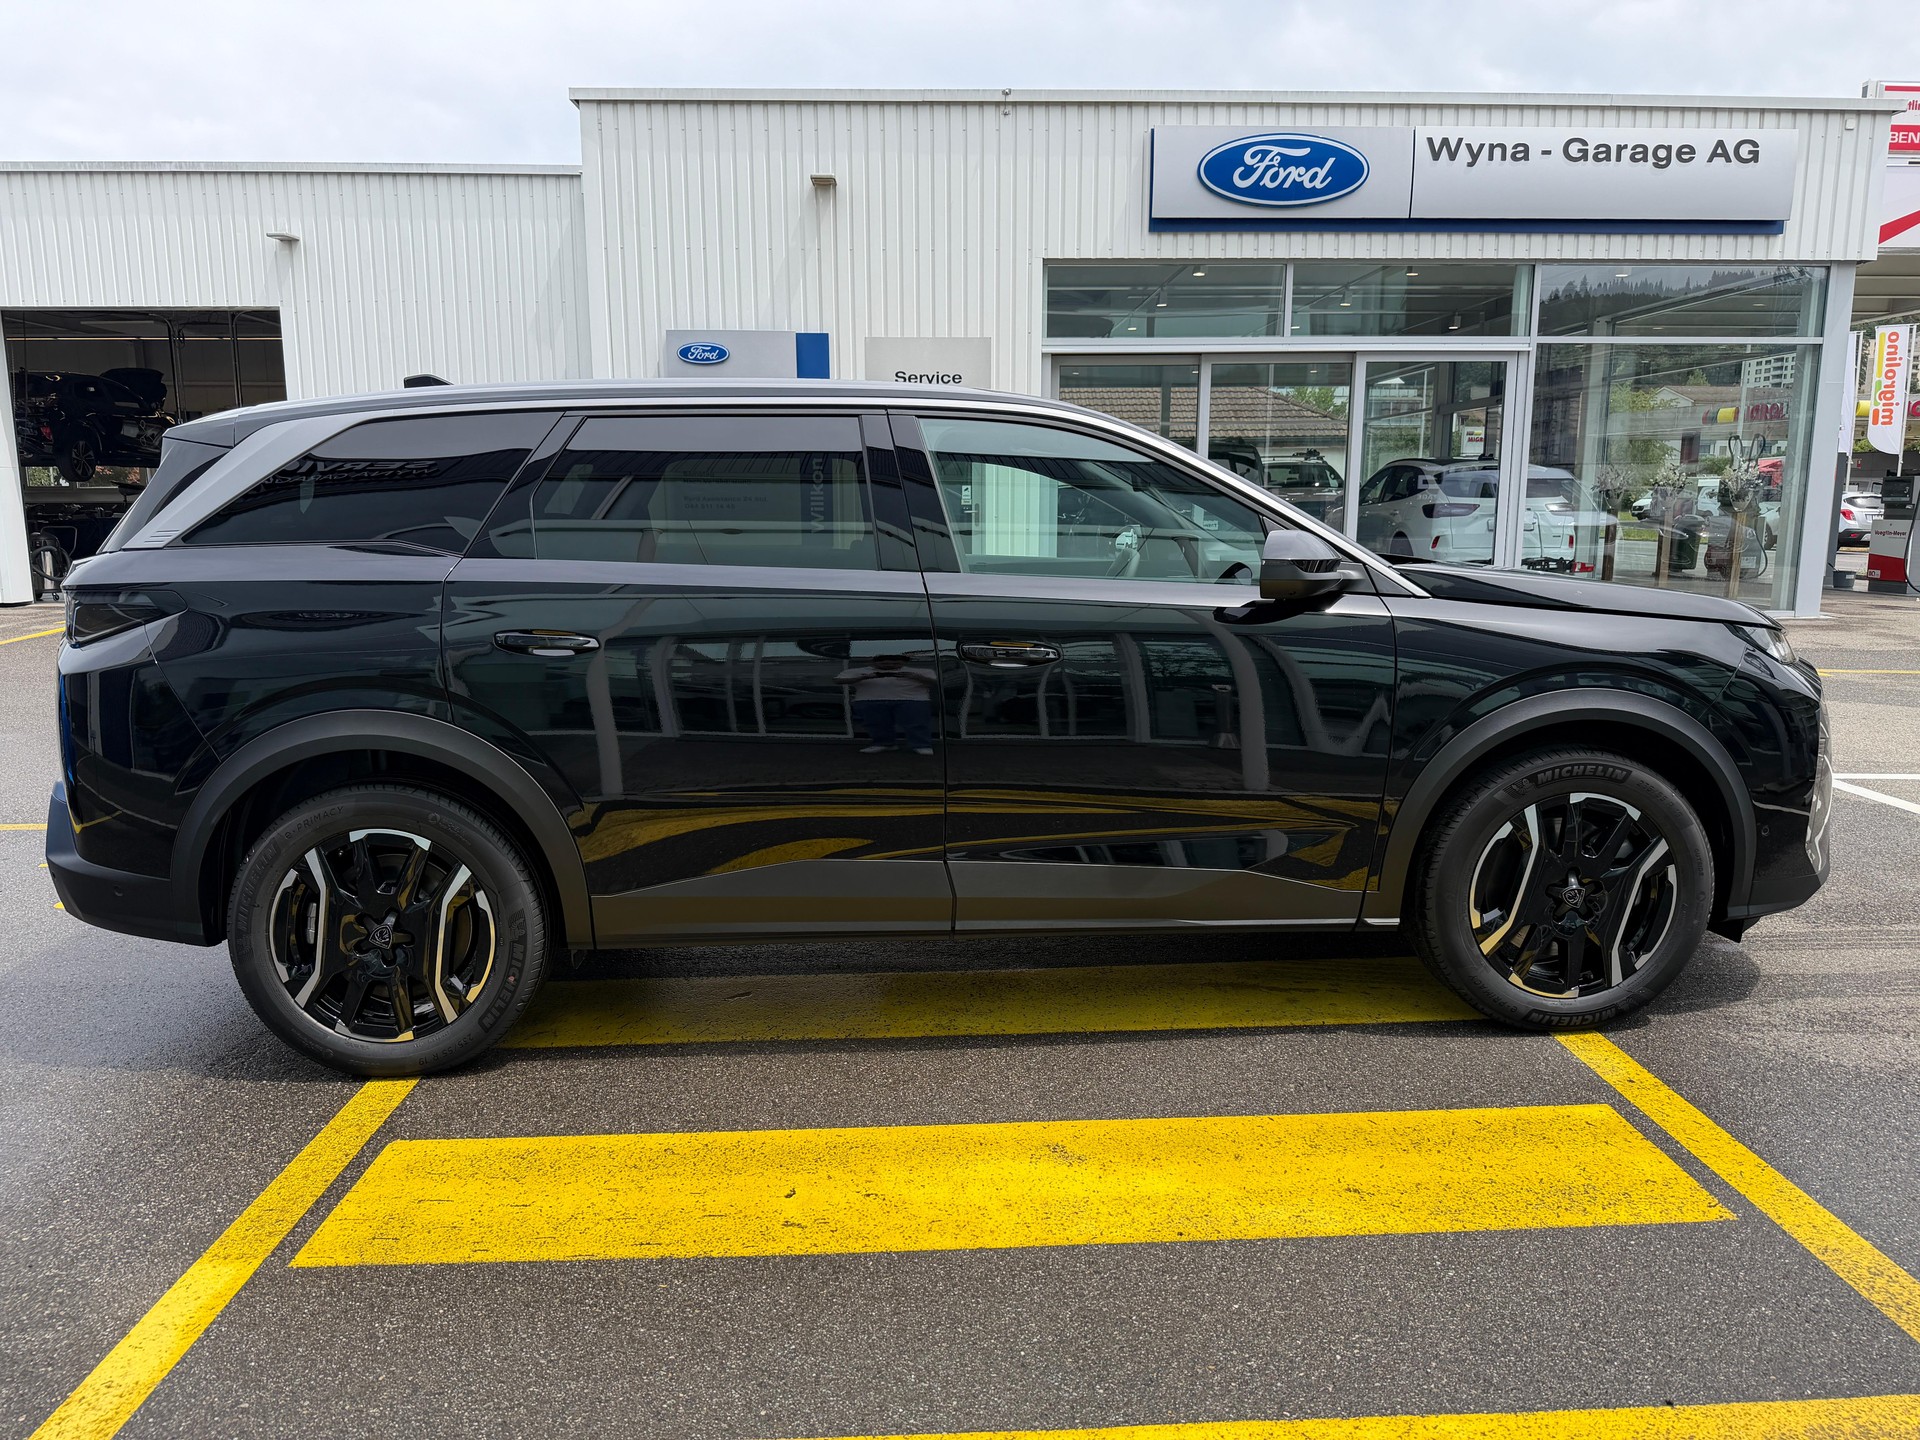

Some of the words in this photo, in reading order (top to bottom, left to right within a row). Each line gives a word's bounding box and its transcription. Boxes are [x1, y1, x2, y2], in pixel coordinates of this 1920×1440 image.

[1426, 137, 1530, 167] Wyna
[1541, 148, 1552, 156] -
[1562, 137, 1696, 169] Garage
[1706, 139, 1760, 164] AG
[1232, 145, 1336, 190] Ford
[687, 345, 720, 360] Ford
[894, 370, 963, 385] Service
[1880, 331, 1903, 426] migrolino
[1537, 764, 1627, 785] MICHELIN
[1526, 1007, 1616, 1026] MICHELIN
